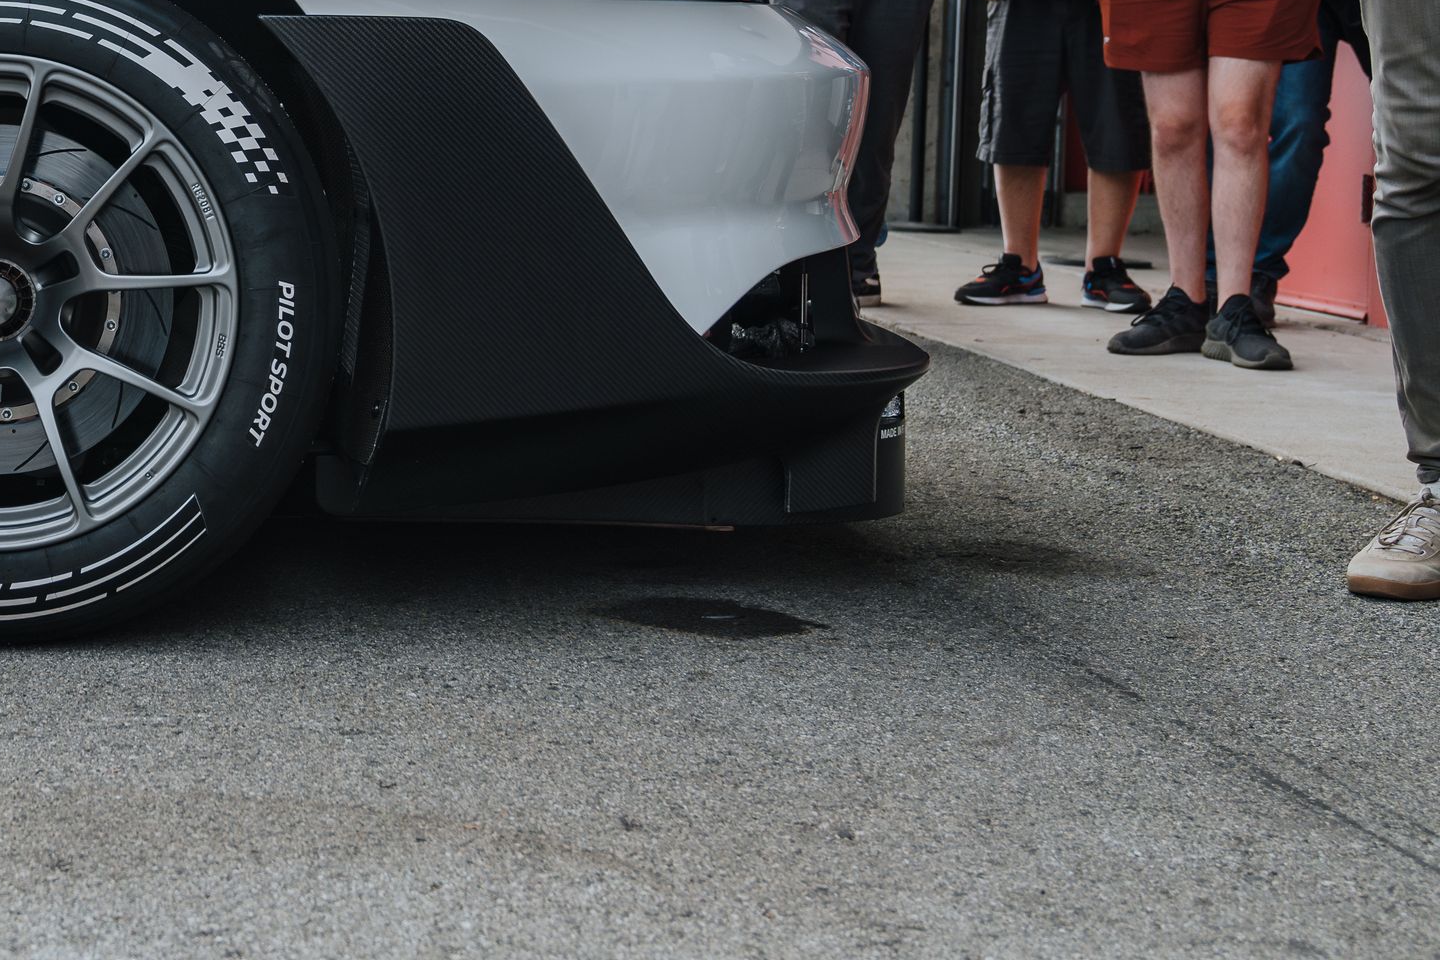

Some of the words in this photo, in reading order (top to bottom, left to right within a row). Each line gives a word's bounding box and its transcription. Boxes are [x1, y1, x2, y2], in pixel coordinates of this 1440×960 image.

[275, 280, 295, 359] PILOT
[215, 333, 227, 359] BBS
[248, 358, 288, 448] SPORT
[880, 427, 897, 439] MADE
